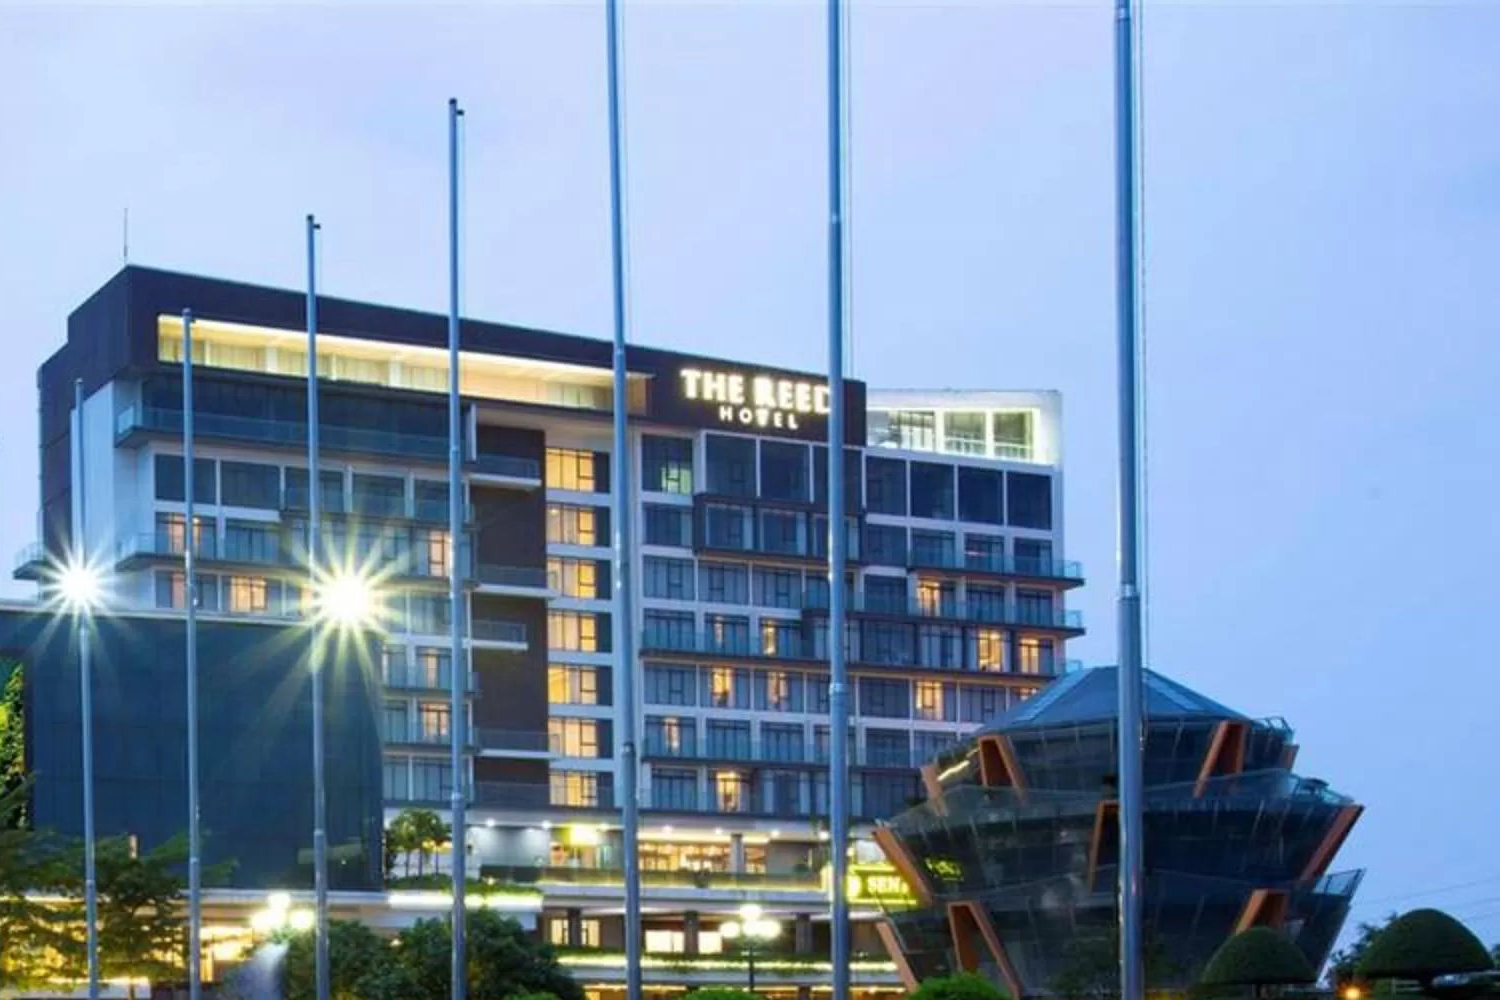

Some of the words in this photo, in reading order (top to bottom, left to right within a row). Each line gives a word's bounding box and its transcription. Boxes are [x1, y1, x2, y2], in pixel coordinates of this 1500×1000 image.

[680, 368, 746, 404] THE
[753, 376, 831, 413] REED
[719, 406, 799, 430] HOTEL
